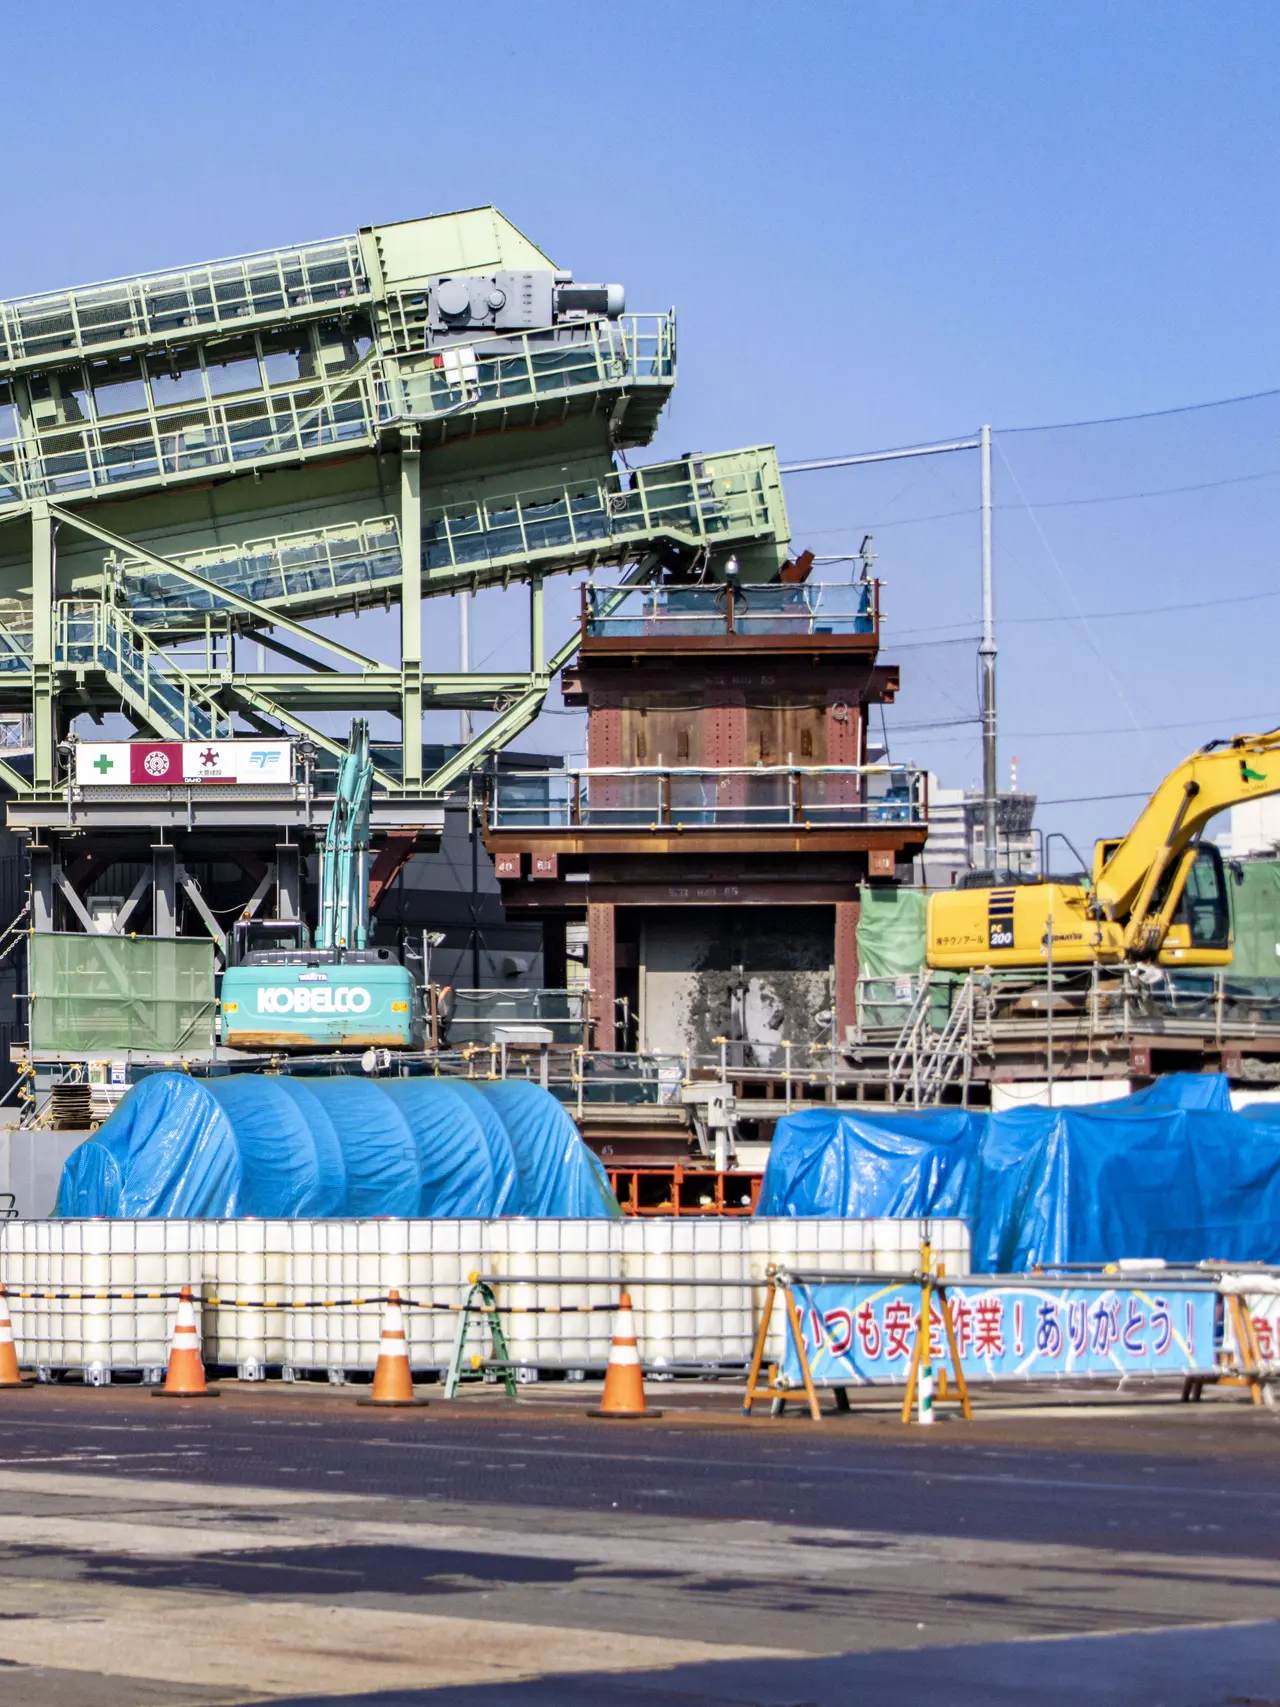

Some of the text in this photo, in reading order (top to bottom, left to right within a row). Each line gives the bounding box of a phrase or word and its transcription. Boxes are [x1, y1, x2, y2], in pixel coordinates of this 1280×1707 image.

[499, 862, 513, 872] 40
[990, 924, 1003, 933] PC
[990, 932, 1013, 945] 200
[256, 986, 372, 1014] KOBELCO
